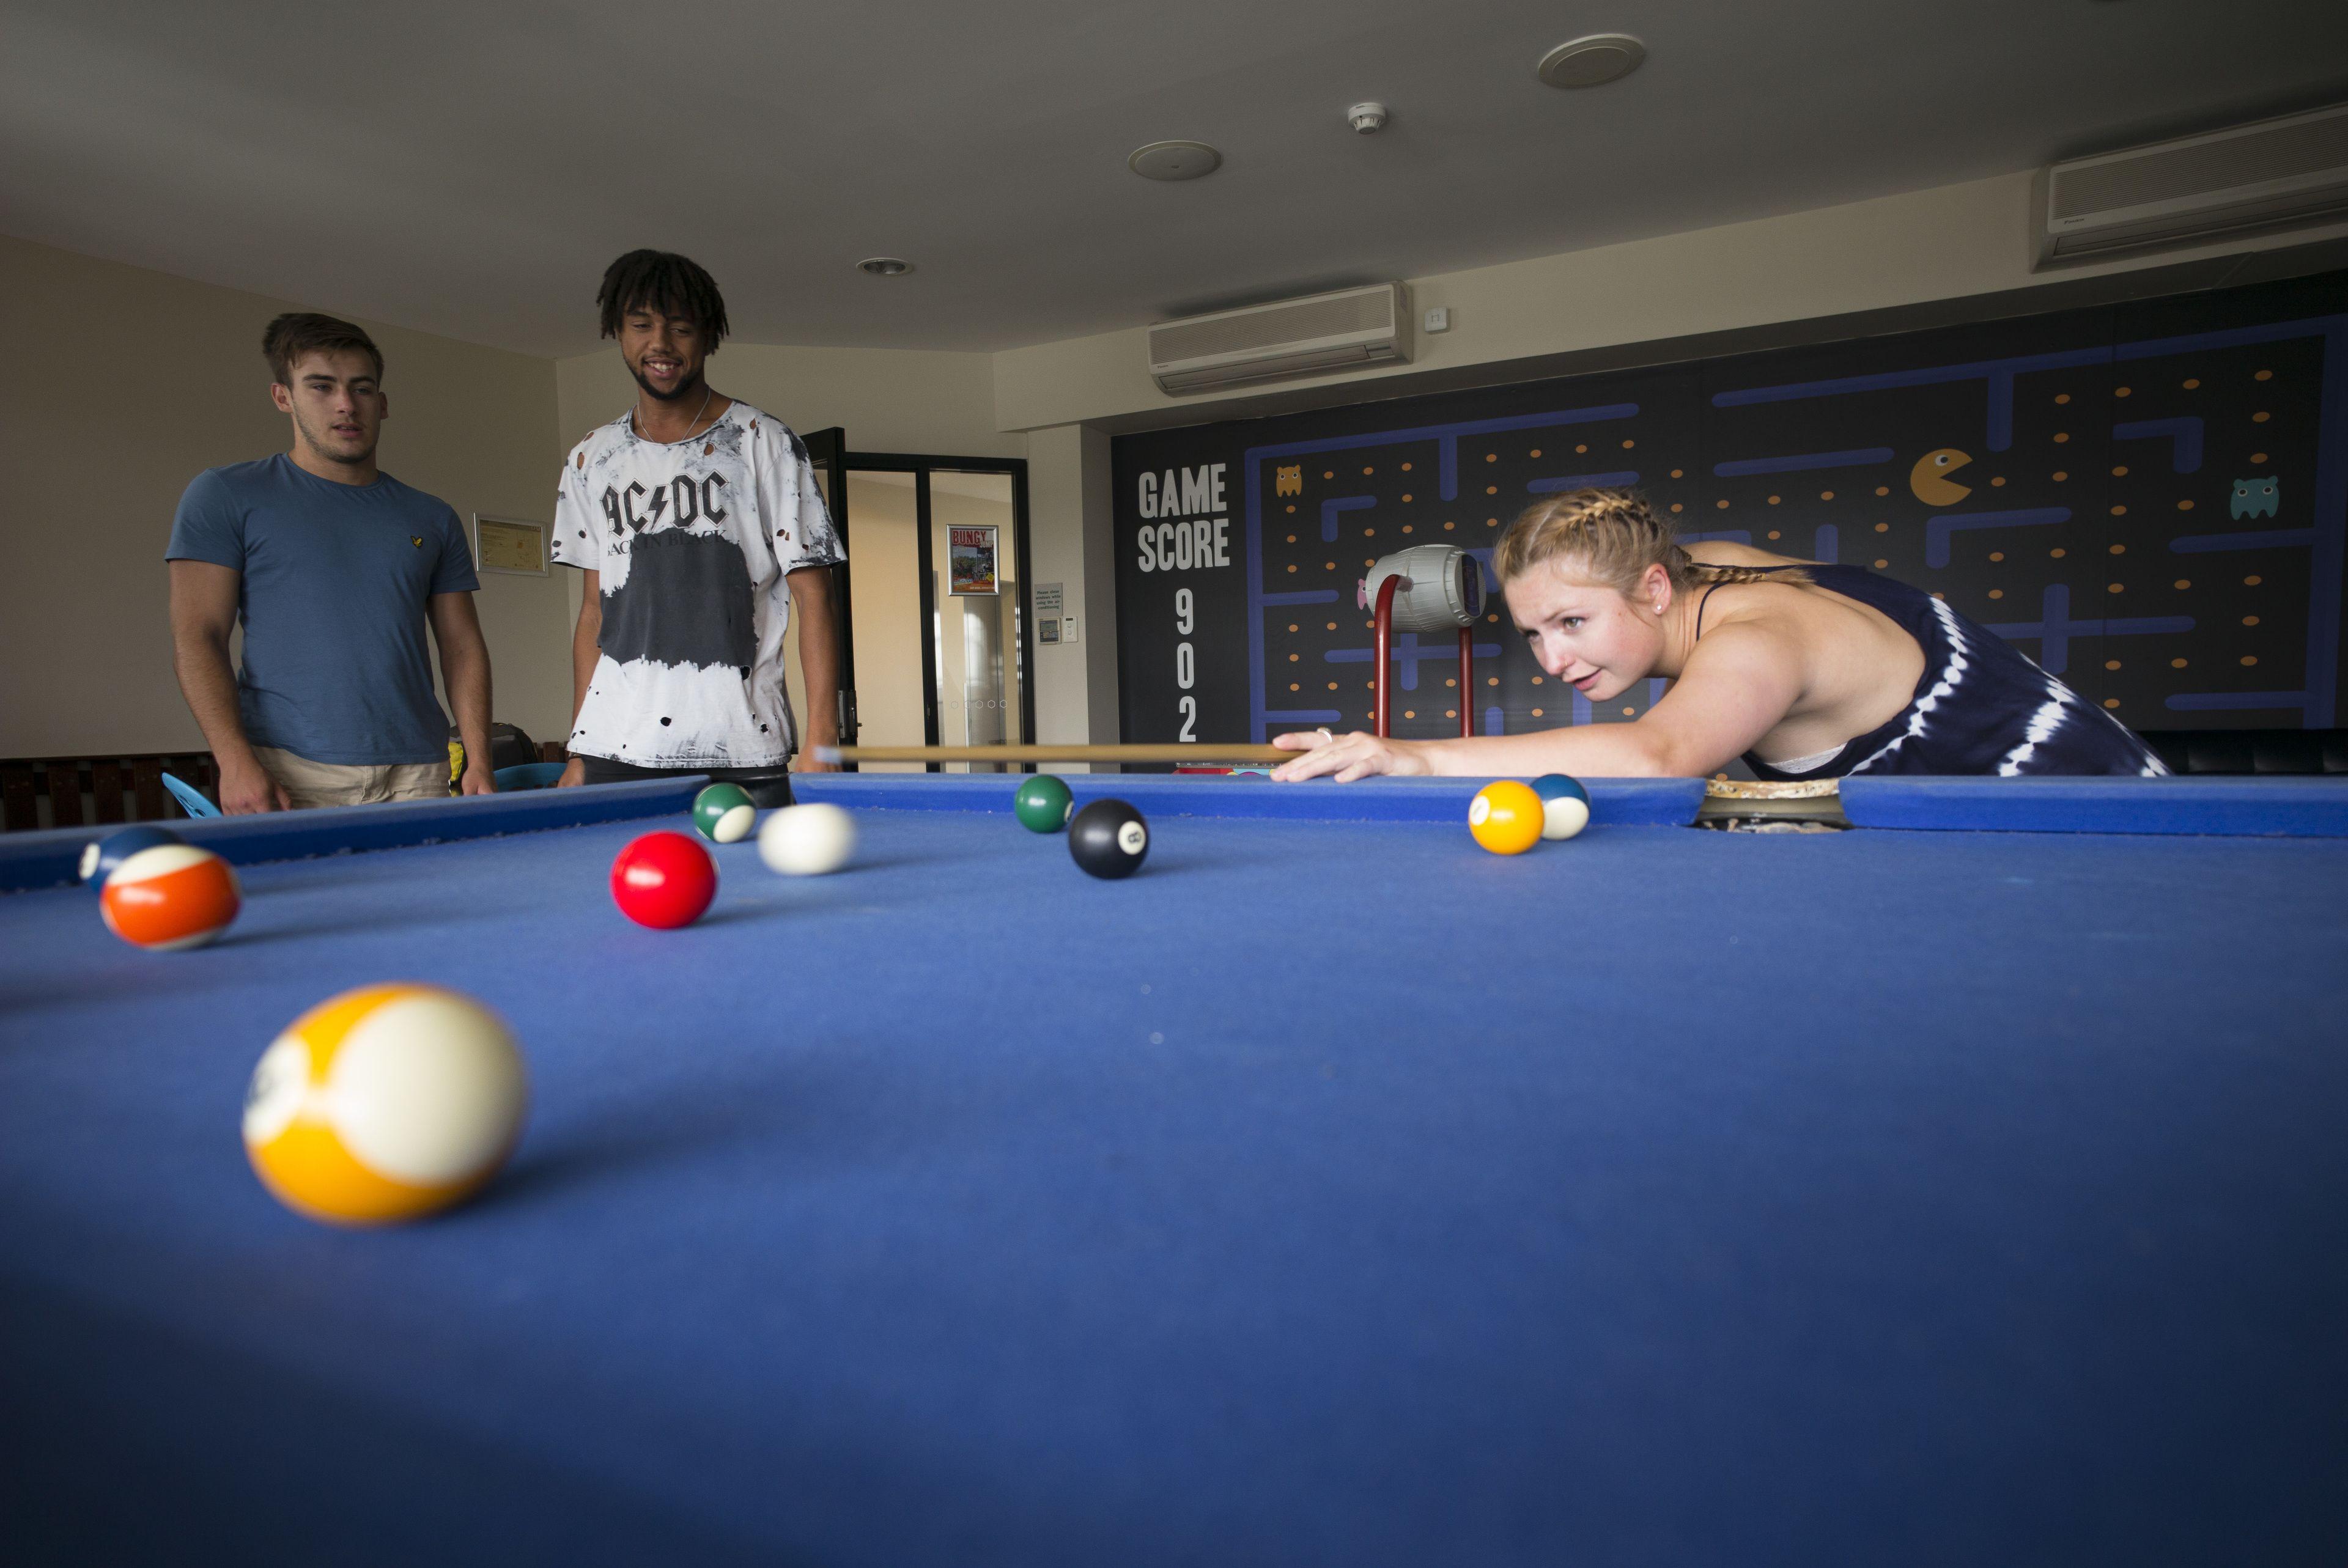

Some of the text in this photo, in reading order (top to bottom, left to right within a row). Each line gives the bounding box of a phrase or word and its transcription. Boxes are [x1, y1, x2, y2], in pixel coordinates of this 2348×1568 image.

[1139, 463, 1227, 518] GAME
[608, 537, 640, 556] ACK
[668, 529, 726, 547] BLACK
[952, 529, 986, 545] BUNGY
[1138, 518, 1230, 573] SCORE
